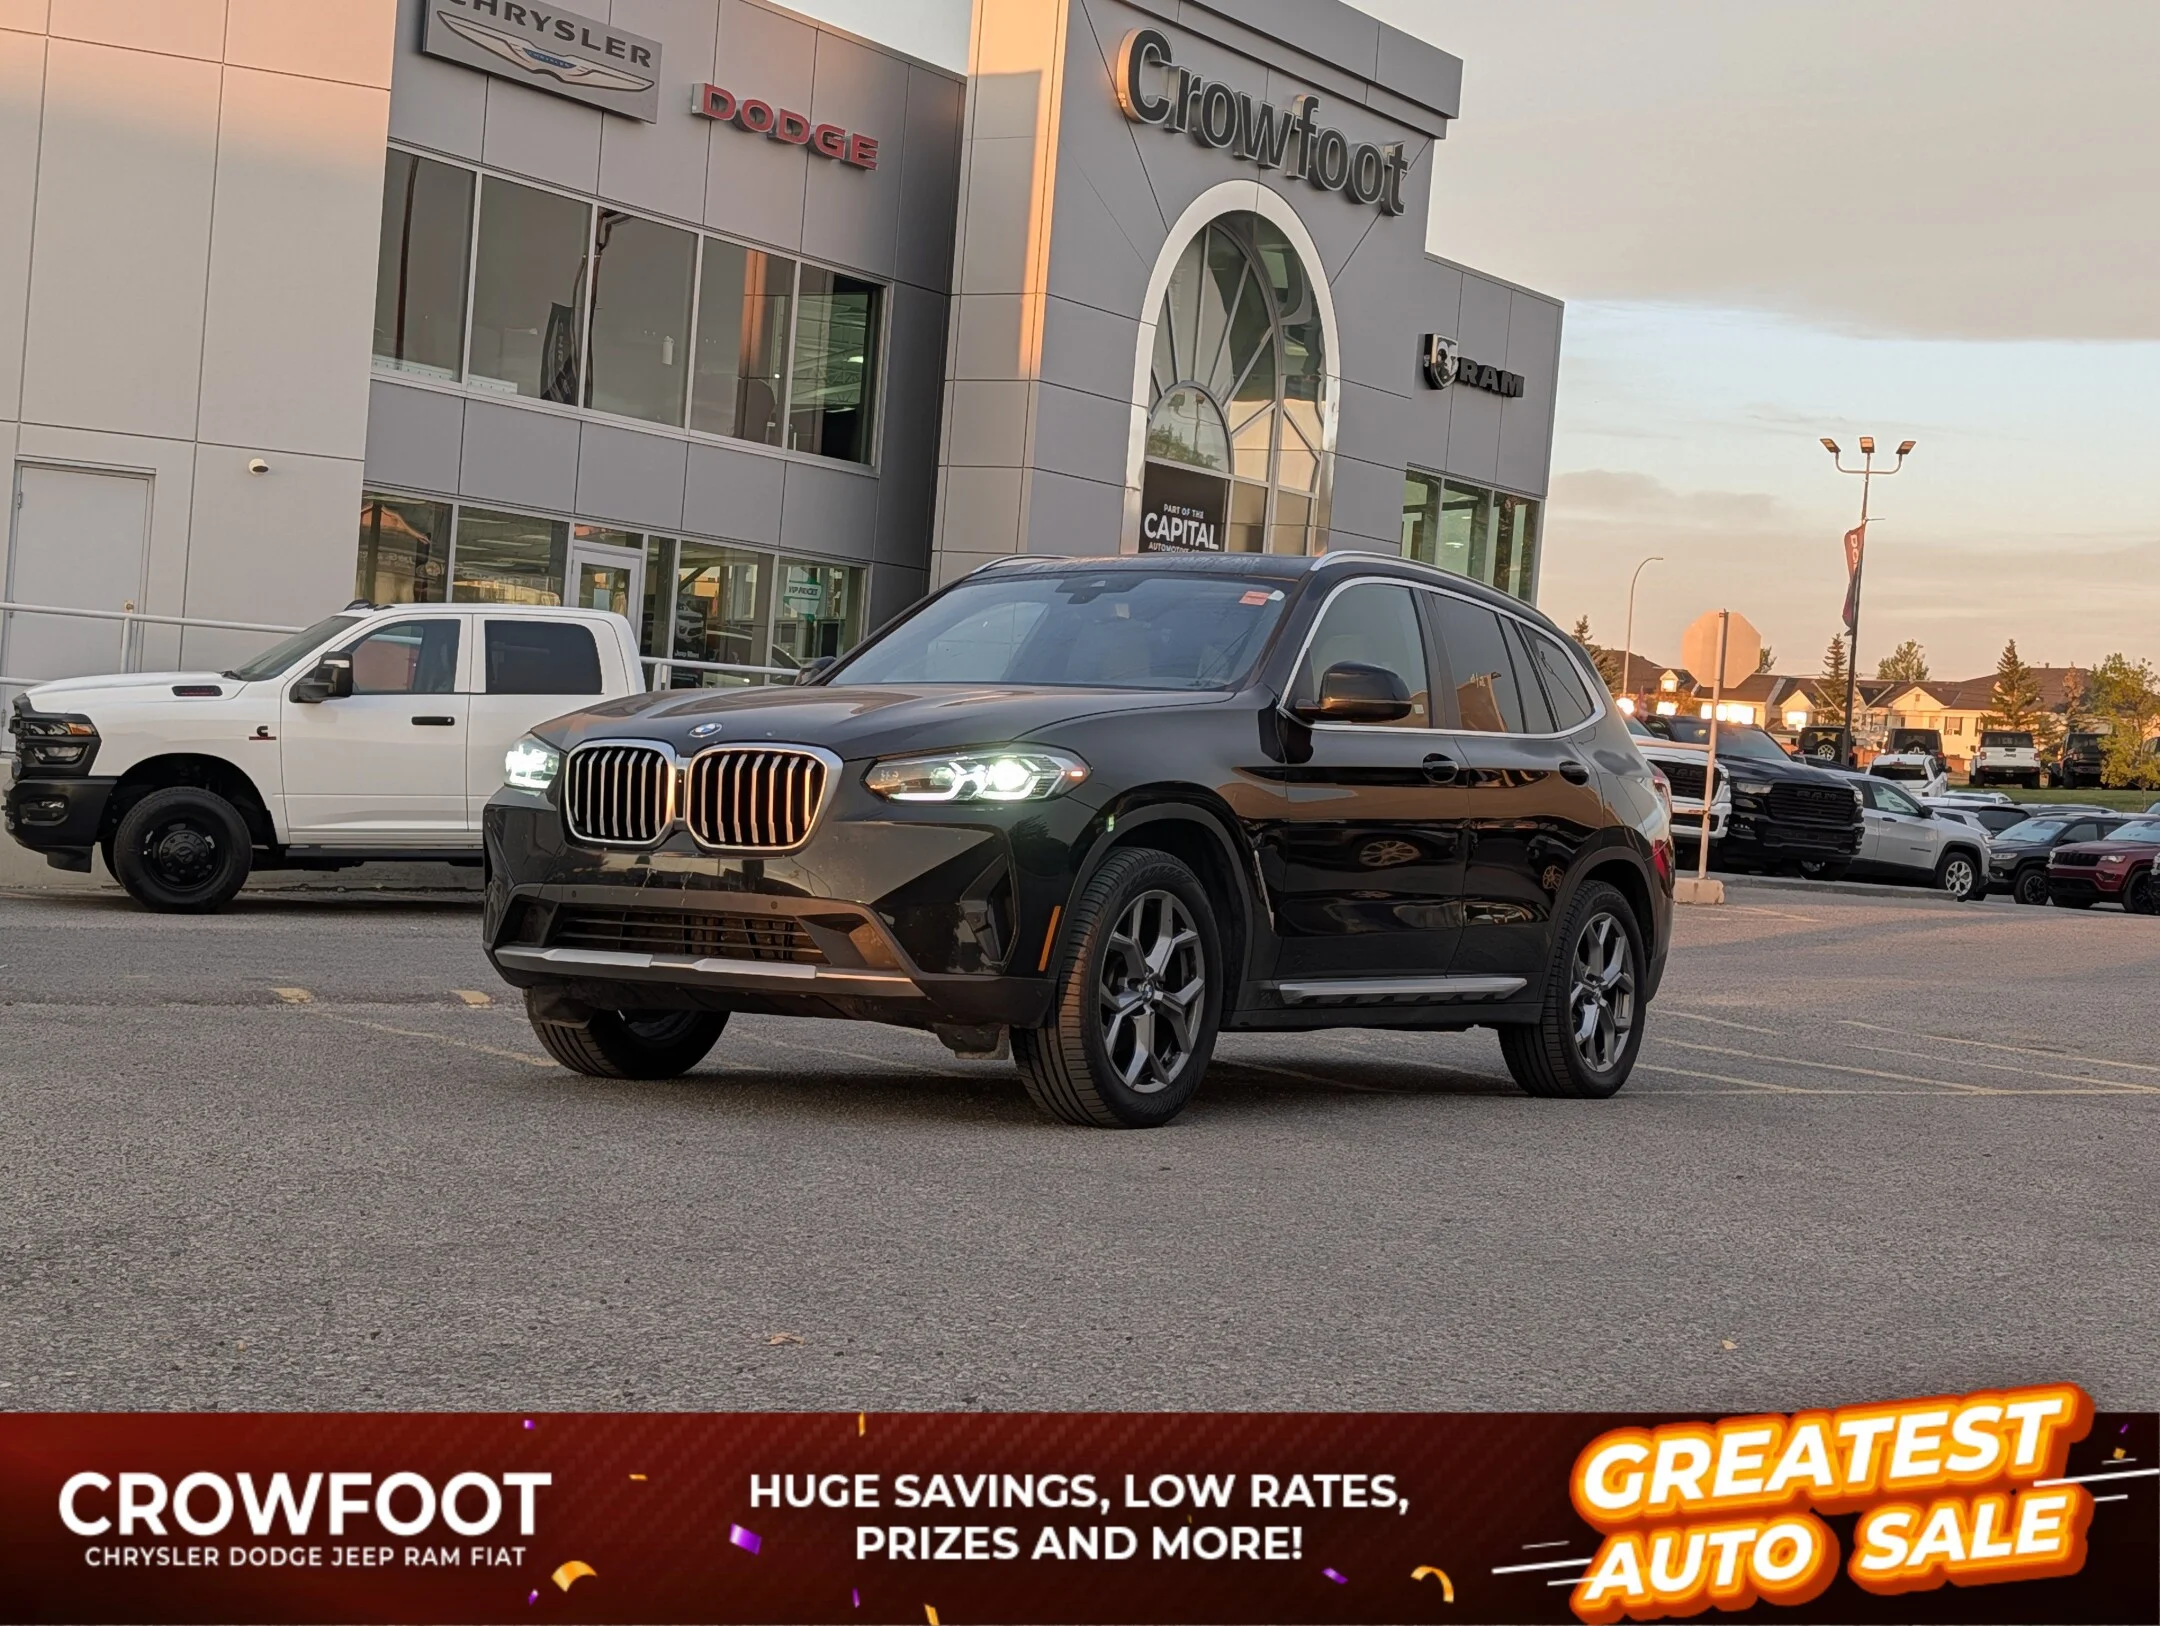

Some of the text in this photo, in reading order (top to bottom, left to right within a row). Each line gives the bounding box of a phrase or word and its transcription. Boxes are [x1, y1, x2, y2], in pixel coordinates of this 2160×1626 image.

[451, 0, 651, 68] HRYSLER
[693, 83, 879, 171] DODGE
[1117, 28, 1408, 216] Crowfoot
[1456, 356, 1525, 398] RAM
[1144, 512, 1219, 550] CAPITAL
[1163, 503, 1204, 519] PART OF THE
